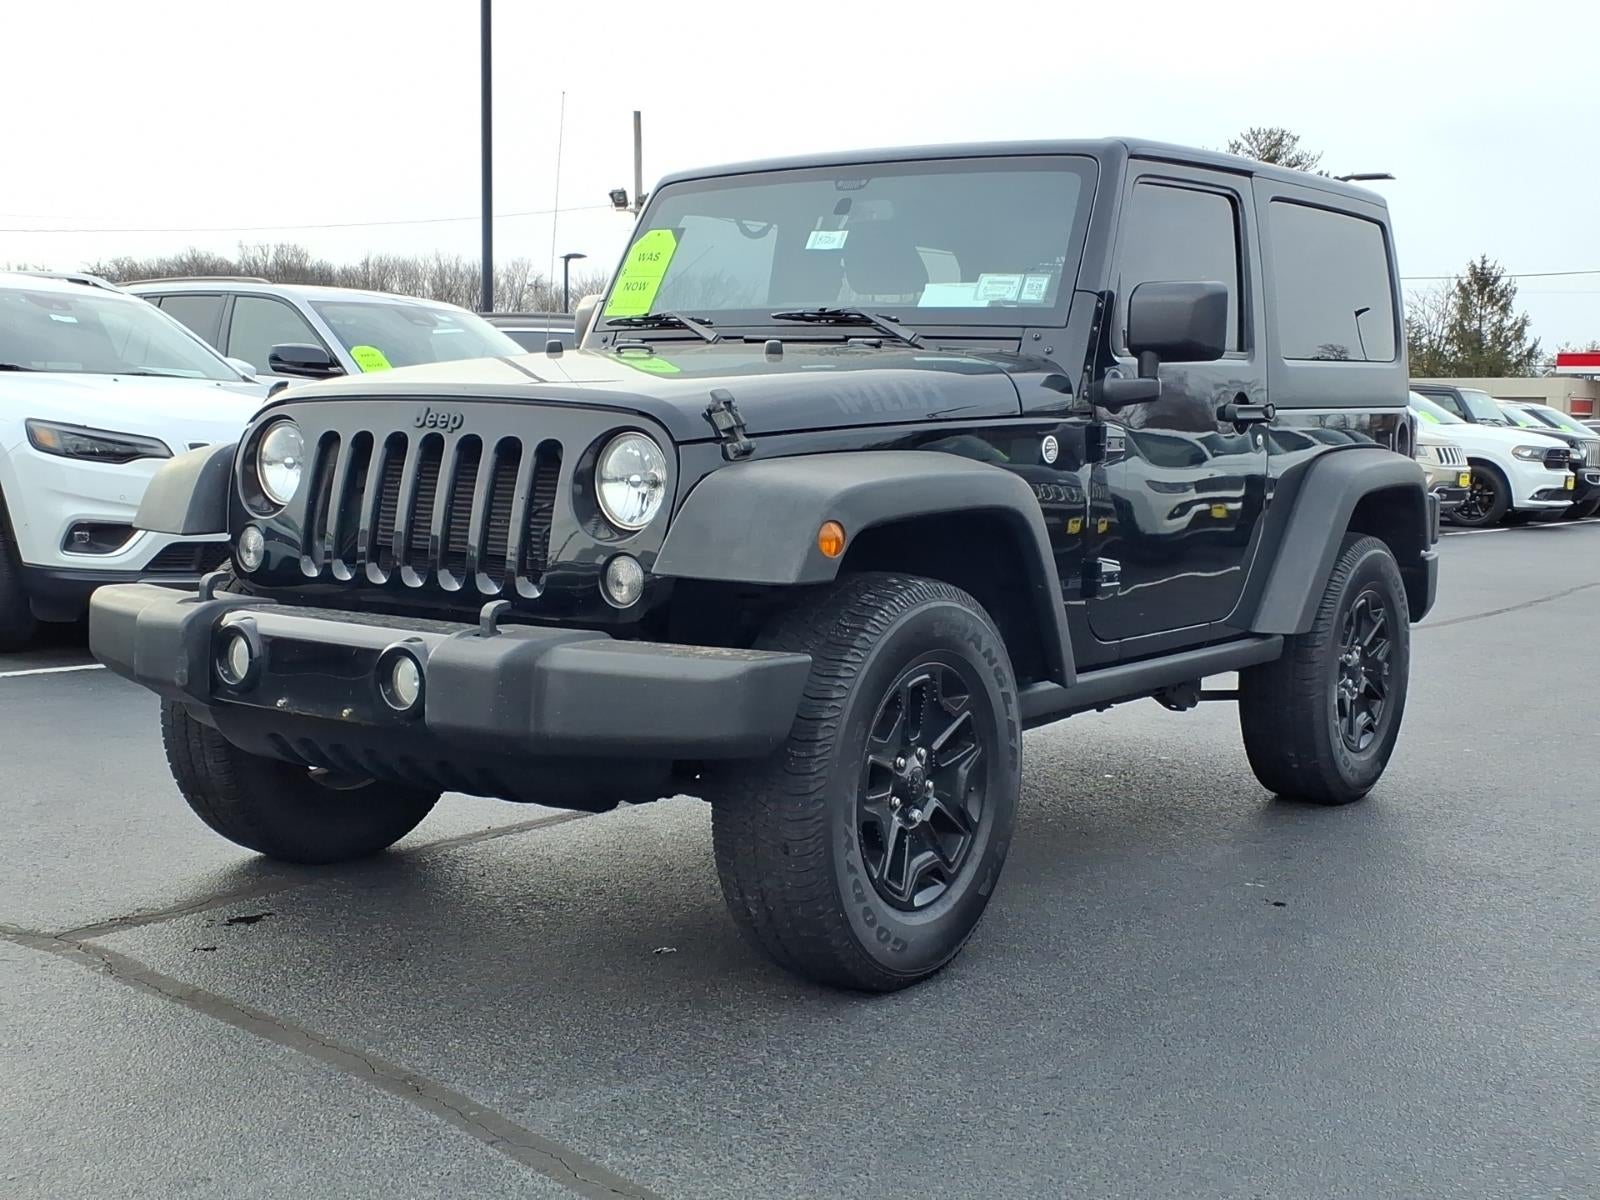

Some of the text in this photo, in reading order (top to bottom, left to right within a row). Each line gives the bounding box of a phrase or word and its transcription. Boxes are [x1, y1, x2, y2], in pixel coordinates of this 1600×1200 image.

[638, 252, 661, 262] WAS
[623, 281, 650, 292] NOW
[414, 407, 465, 433] Jeep
